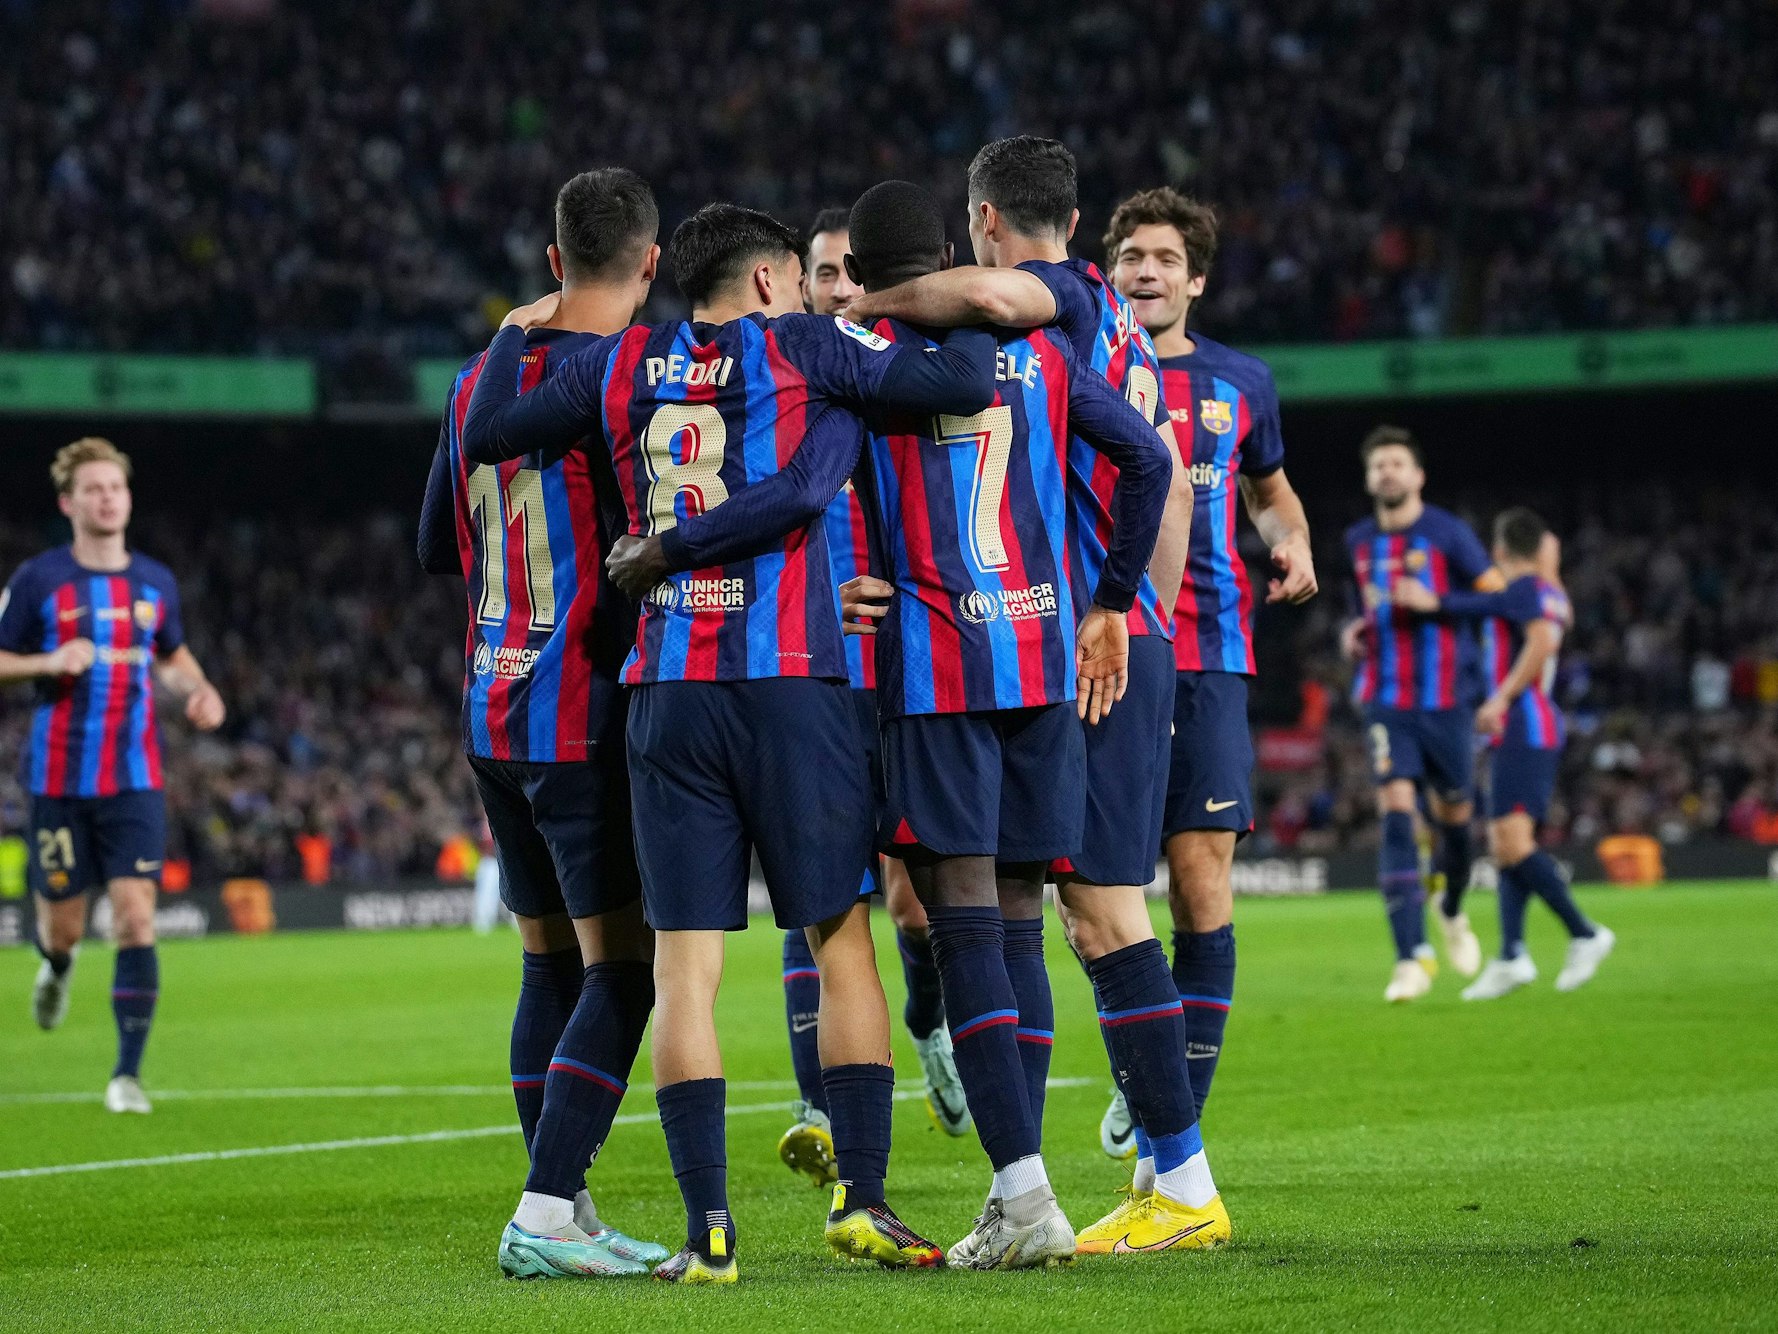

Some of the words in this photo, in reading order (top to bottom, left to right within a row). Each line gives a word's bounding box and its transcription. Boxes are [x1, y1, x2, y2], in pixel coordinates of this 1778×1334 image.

[646, 355, 735, 388] PEDRI
[640, 403, 730, 538] 8
[934, 405, 1014, 573] 7
[467, 464, 556, 632] 11
[681, 578, 745, 593] UNHCR
[681, 592, 745, 607] ACNUR
[997, 583, 1054, 603] UNHCR
[1002, 596, 1057, 616] ACNUR
[37, 826, 76, 869] 21
